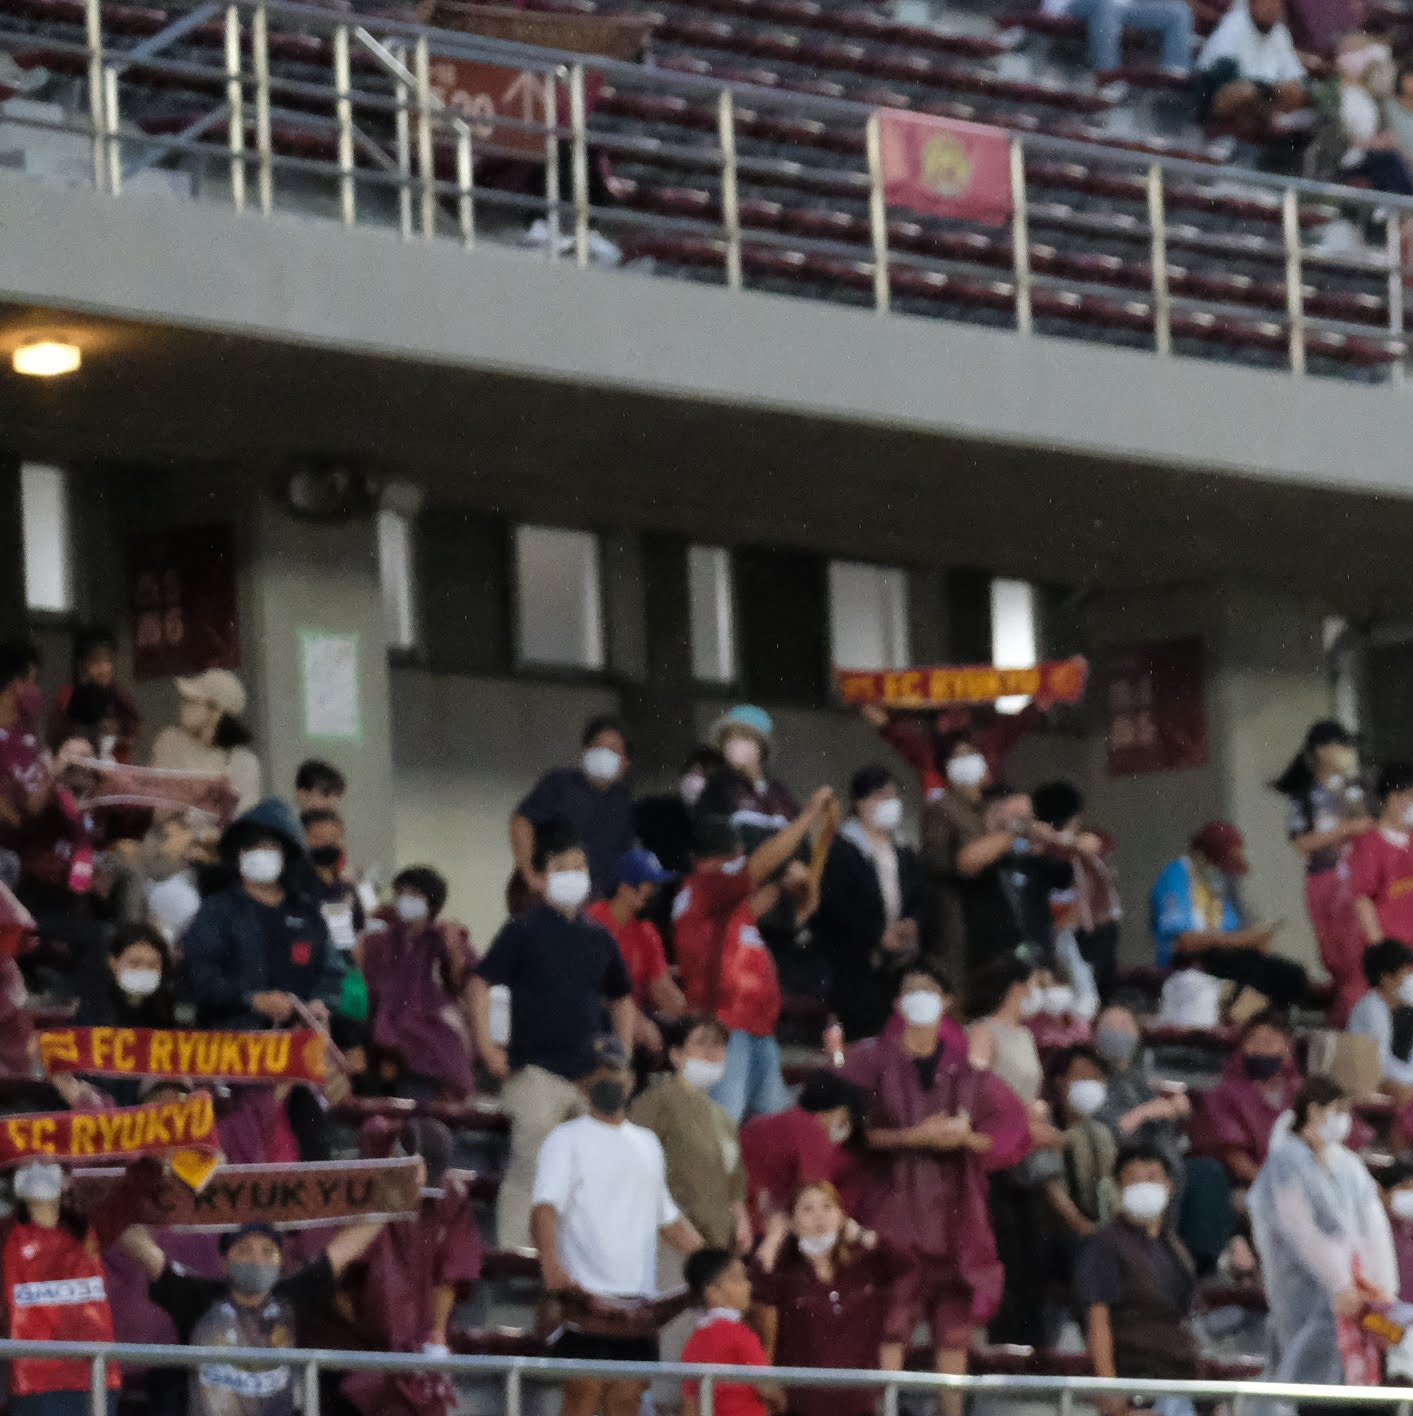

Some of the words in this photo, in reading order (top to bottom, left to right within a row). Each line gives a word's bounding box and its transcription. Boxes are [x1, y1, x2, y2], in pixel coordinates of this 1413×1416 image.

[91, 1026, 137, 1071] FC
[149, 1032, 293, 1075] RYUKYU
[7, 1117, 57, 1155] FC
[69, 1096, 215, 1156] RYUKYU
[192, 1178, 376, 1213] RYUKYU
